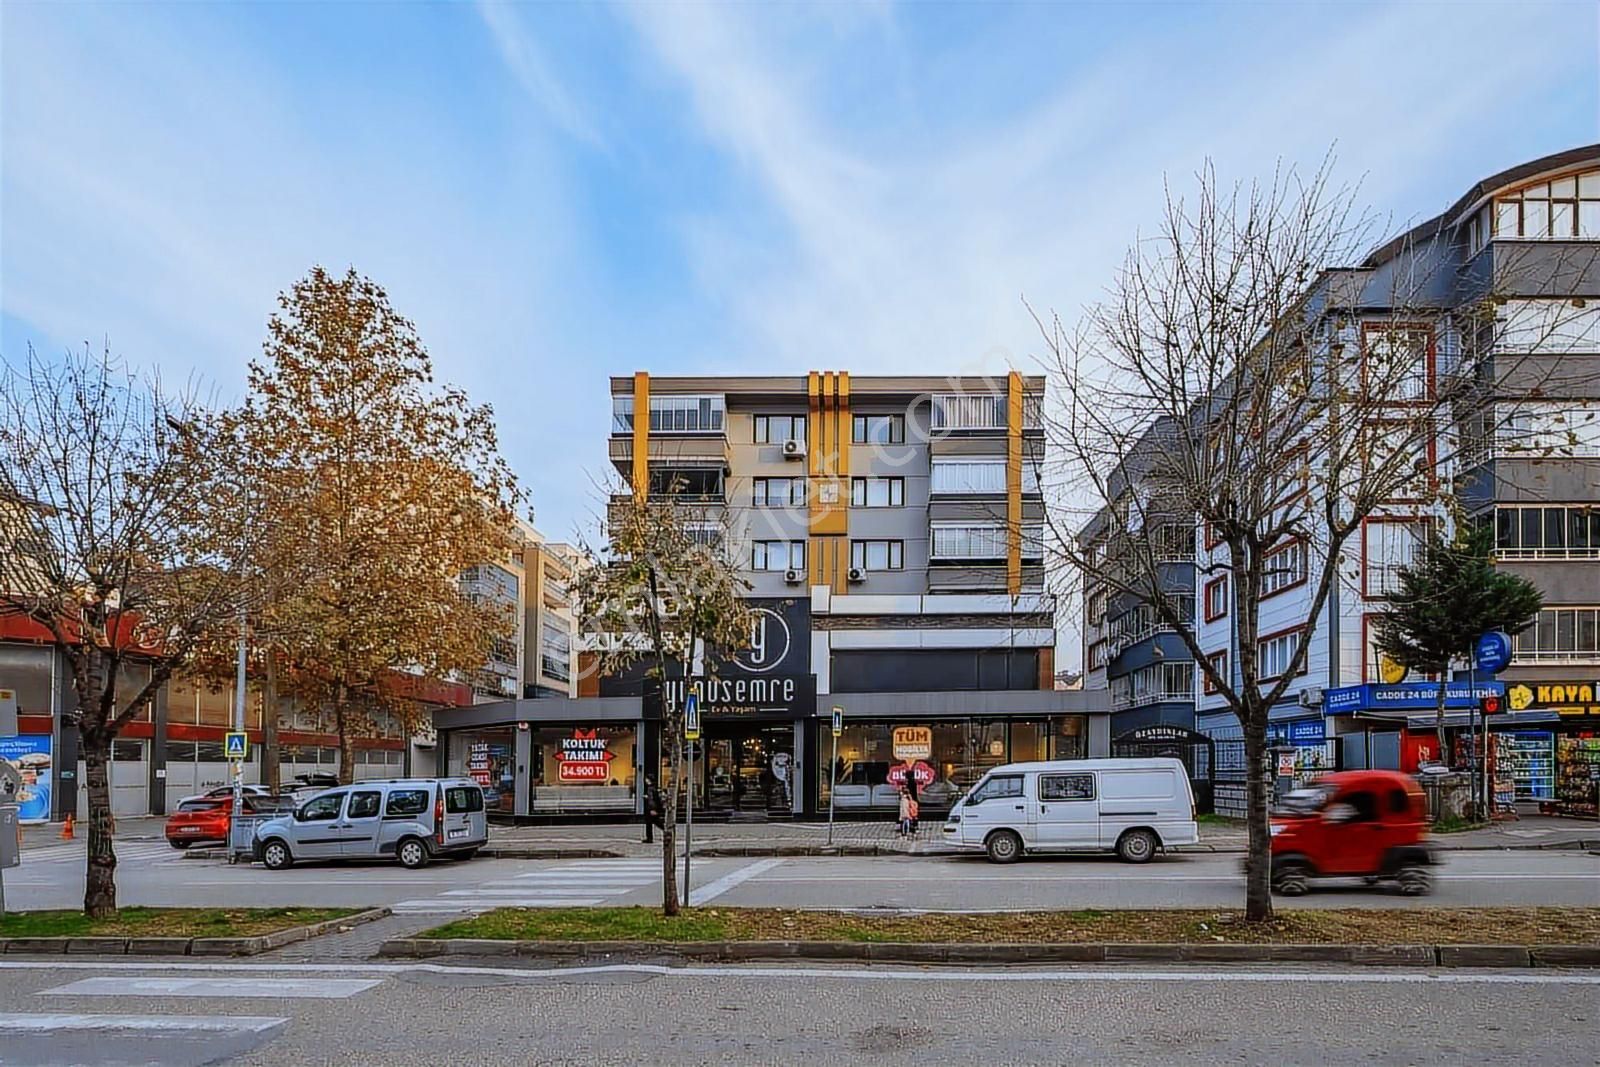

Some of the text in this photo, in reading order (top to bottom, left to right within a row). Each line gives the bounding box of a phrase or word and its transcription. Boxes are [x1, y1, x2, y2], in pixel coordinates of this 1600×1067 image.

[1537, 685, 1593, 703] KAYA
[896, 728, 928, 742] TÜM
[562, 738, 606, 749] KOLTUK
[562, 750, 604, 761] TAKIMI
